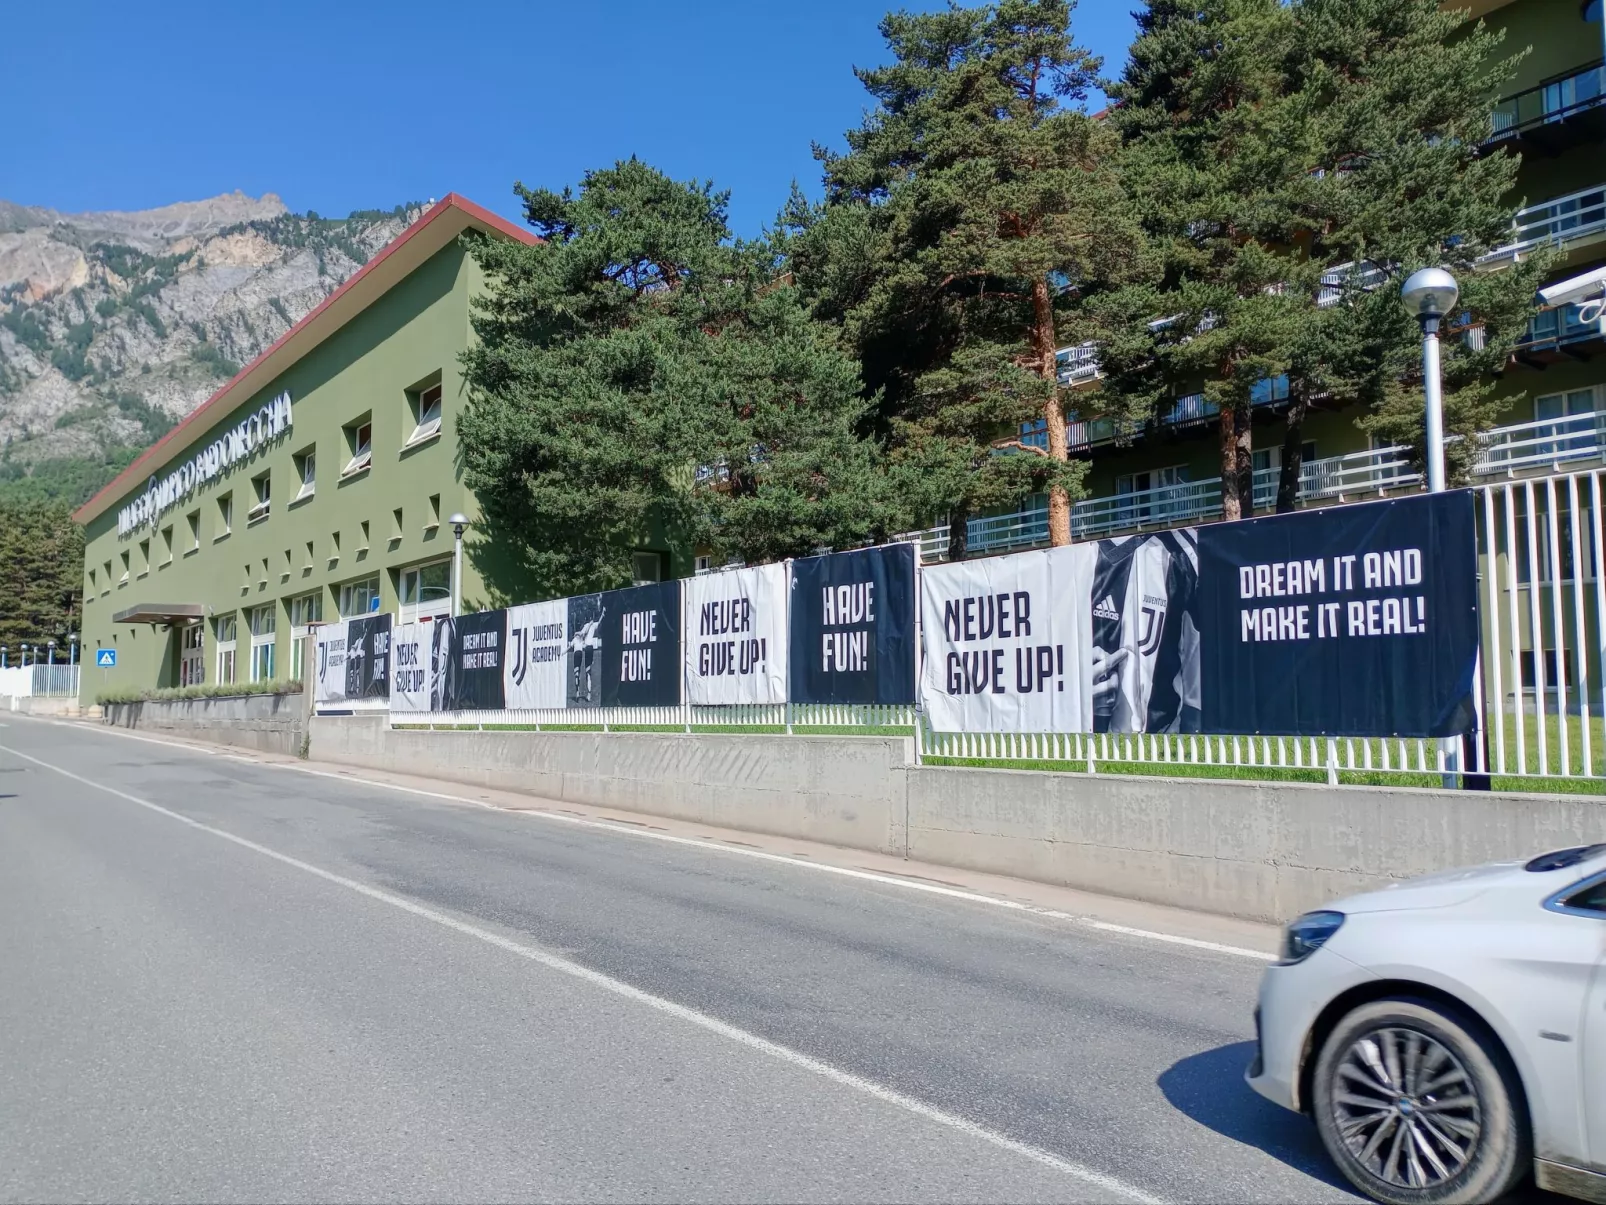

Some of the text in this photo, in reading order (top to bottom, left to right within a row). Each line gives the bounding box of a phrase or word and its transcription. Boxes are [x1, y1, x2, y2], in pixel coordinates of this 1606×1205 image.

[1239, 548, 1422, 599] DREAM IT AND
[700, 598, 749, 636] NEVER
[822, 581, 874, 626] HAVE
[944, 591, 1031, 642] NEVER
[1093, 609, 1119, 621] adidas
[1241, 596, 1426, 642] MAKE IT REAL!
[532, 622, 563, 642] JUVENTUS
[622, 610, 657, 645] HAVE
[532, 644, 561, 663] ACADEMY
[621, 649, 651, 682] FUN!
[700, 638, 765, 677] GIVE UP!
[822, 630, 868, 672] FUN!
[946, 644, 1063, 695] GIVE UP!
